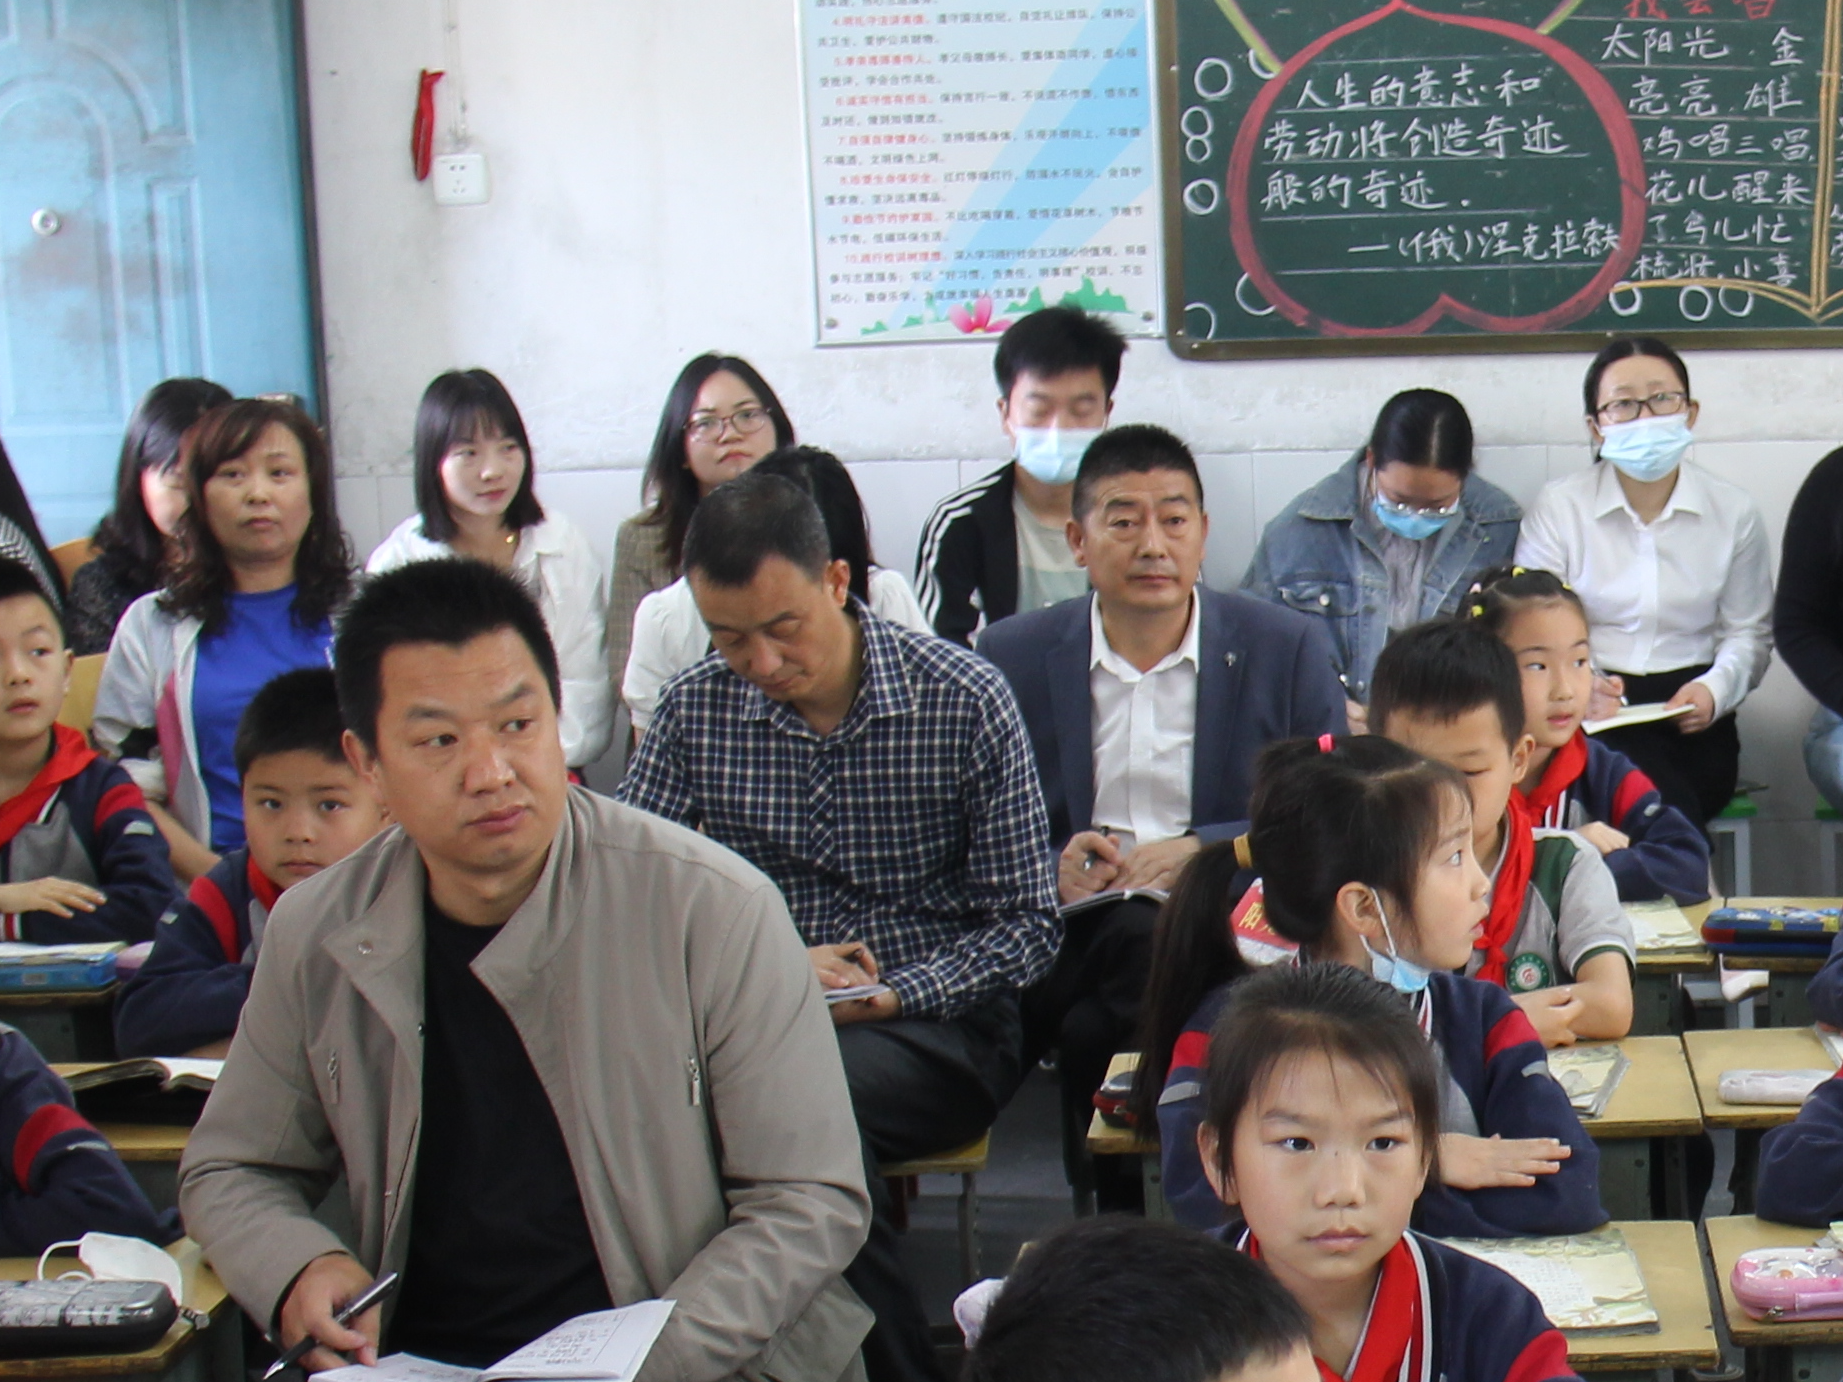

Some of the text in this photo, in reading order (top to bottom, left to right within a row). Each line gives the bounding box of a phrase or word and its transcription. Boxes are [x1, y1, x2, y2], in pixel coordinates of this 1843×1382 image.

[1297, 63, 1541, 109] 人生的意志和
[1263, 114, 1569, 161] 劳动将创造奇迹
[1645, 170, 1812, 205] 花儿醒来
